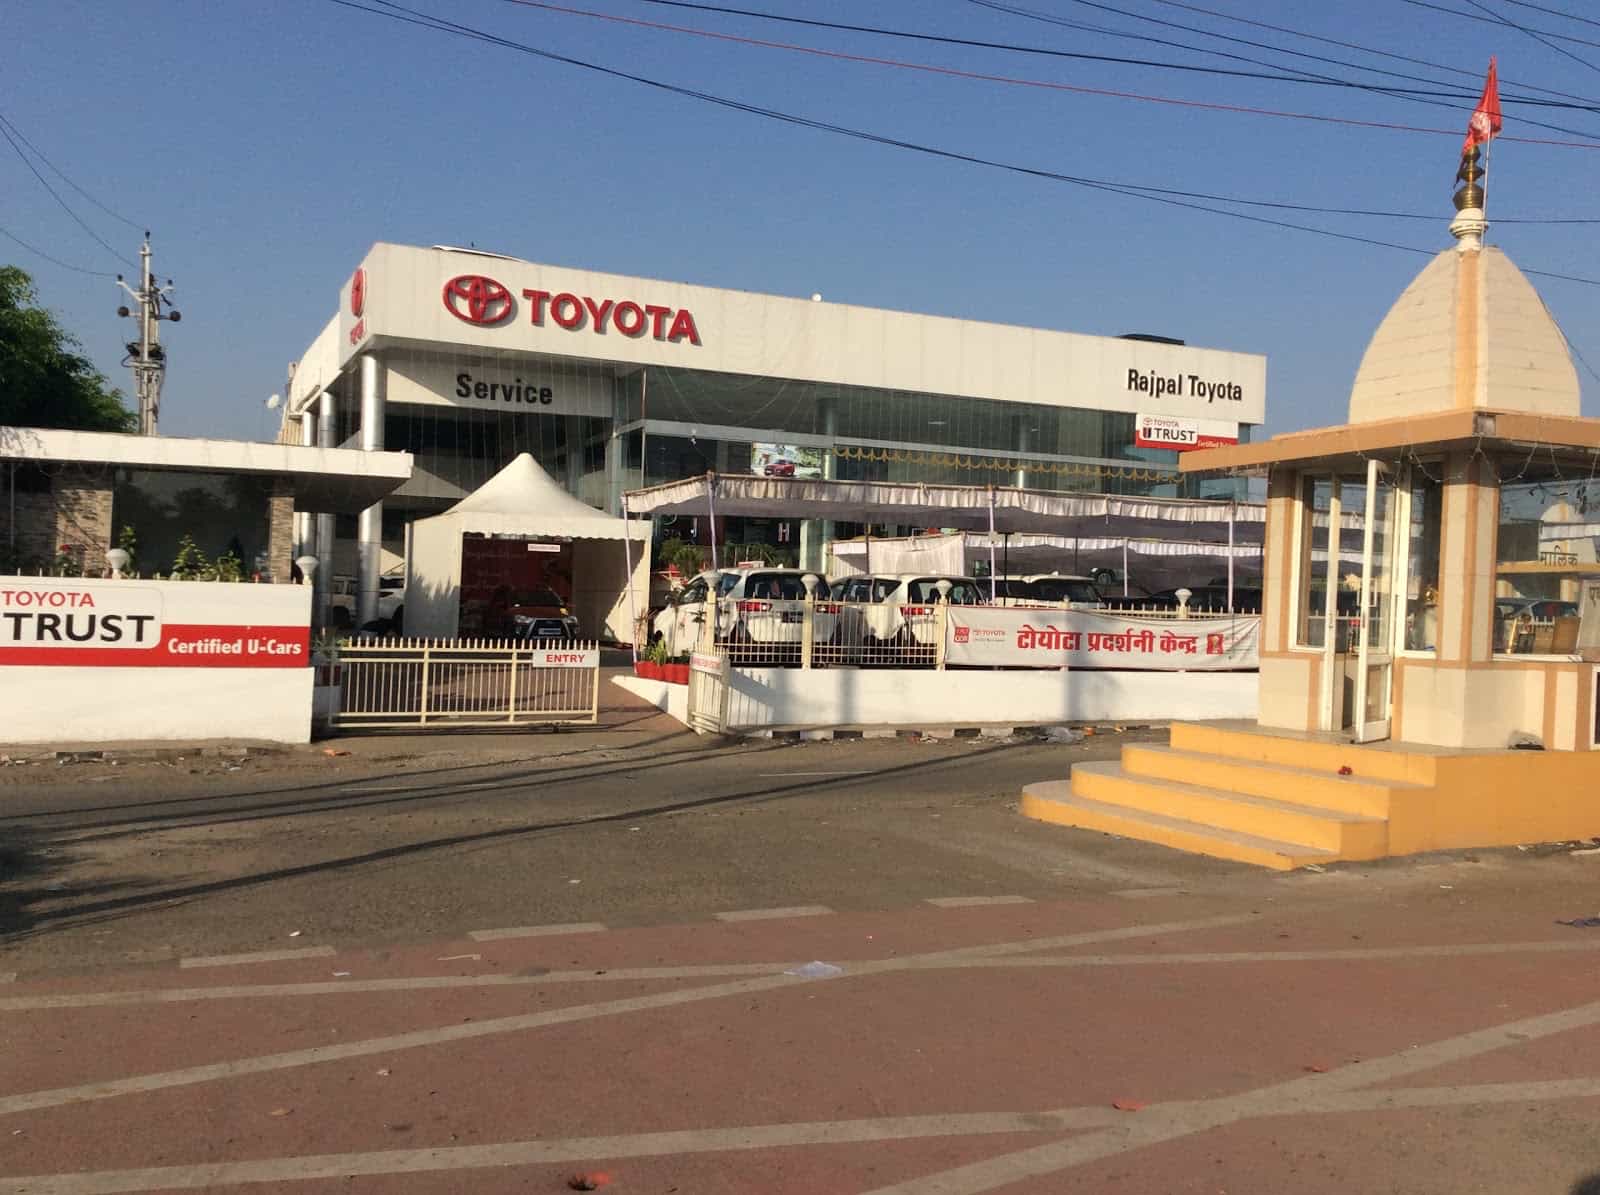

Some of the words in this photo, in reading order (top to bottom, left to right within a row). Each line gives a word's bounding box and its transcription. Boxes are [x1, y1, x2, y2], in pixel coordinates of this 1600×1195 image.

[522, 288, 700, 345] TOYOTA
[456, 373, 553, 405] Service
[1128, 368, 1182, 398] Rajpal
[1188, 375, 1242, 403] Toyota
[1154, 427, 1197, 442] TRUST
[1540, 545, 1578, 567] मालिक
[1, 590, 95, 608] TOYOTA
[3, 612, 155, 643] TRUST
[1017, 624, 1081, 650] टोयोटा
[1087, 627, 1156, 653] प्रदर्शनी
[1160, 628, 1199, 653] केन्द्र
[167, 638, 242, 655] Certified
[248, 638, 302, 655] U-Cars
[545, 653, 586, 664] ENTRY
